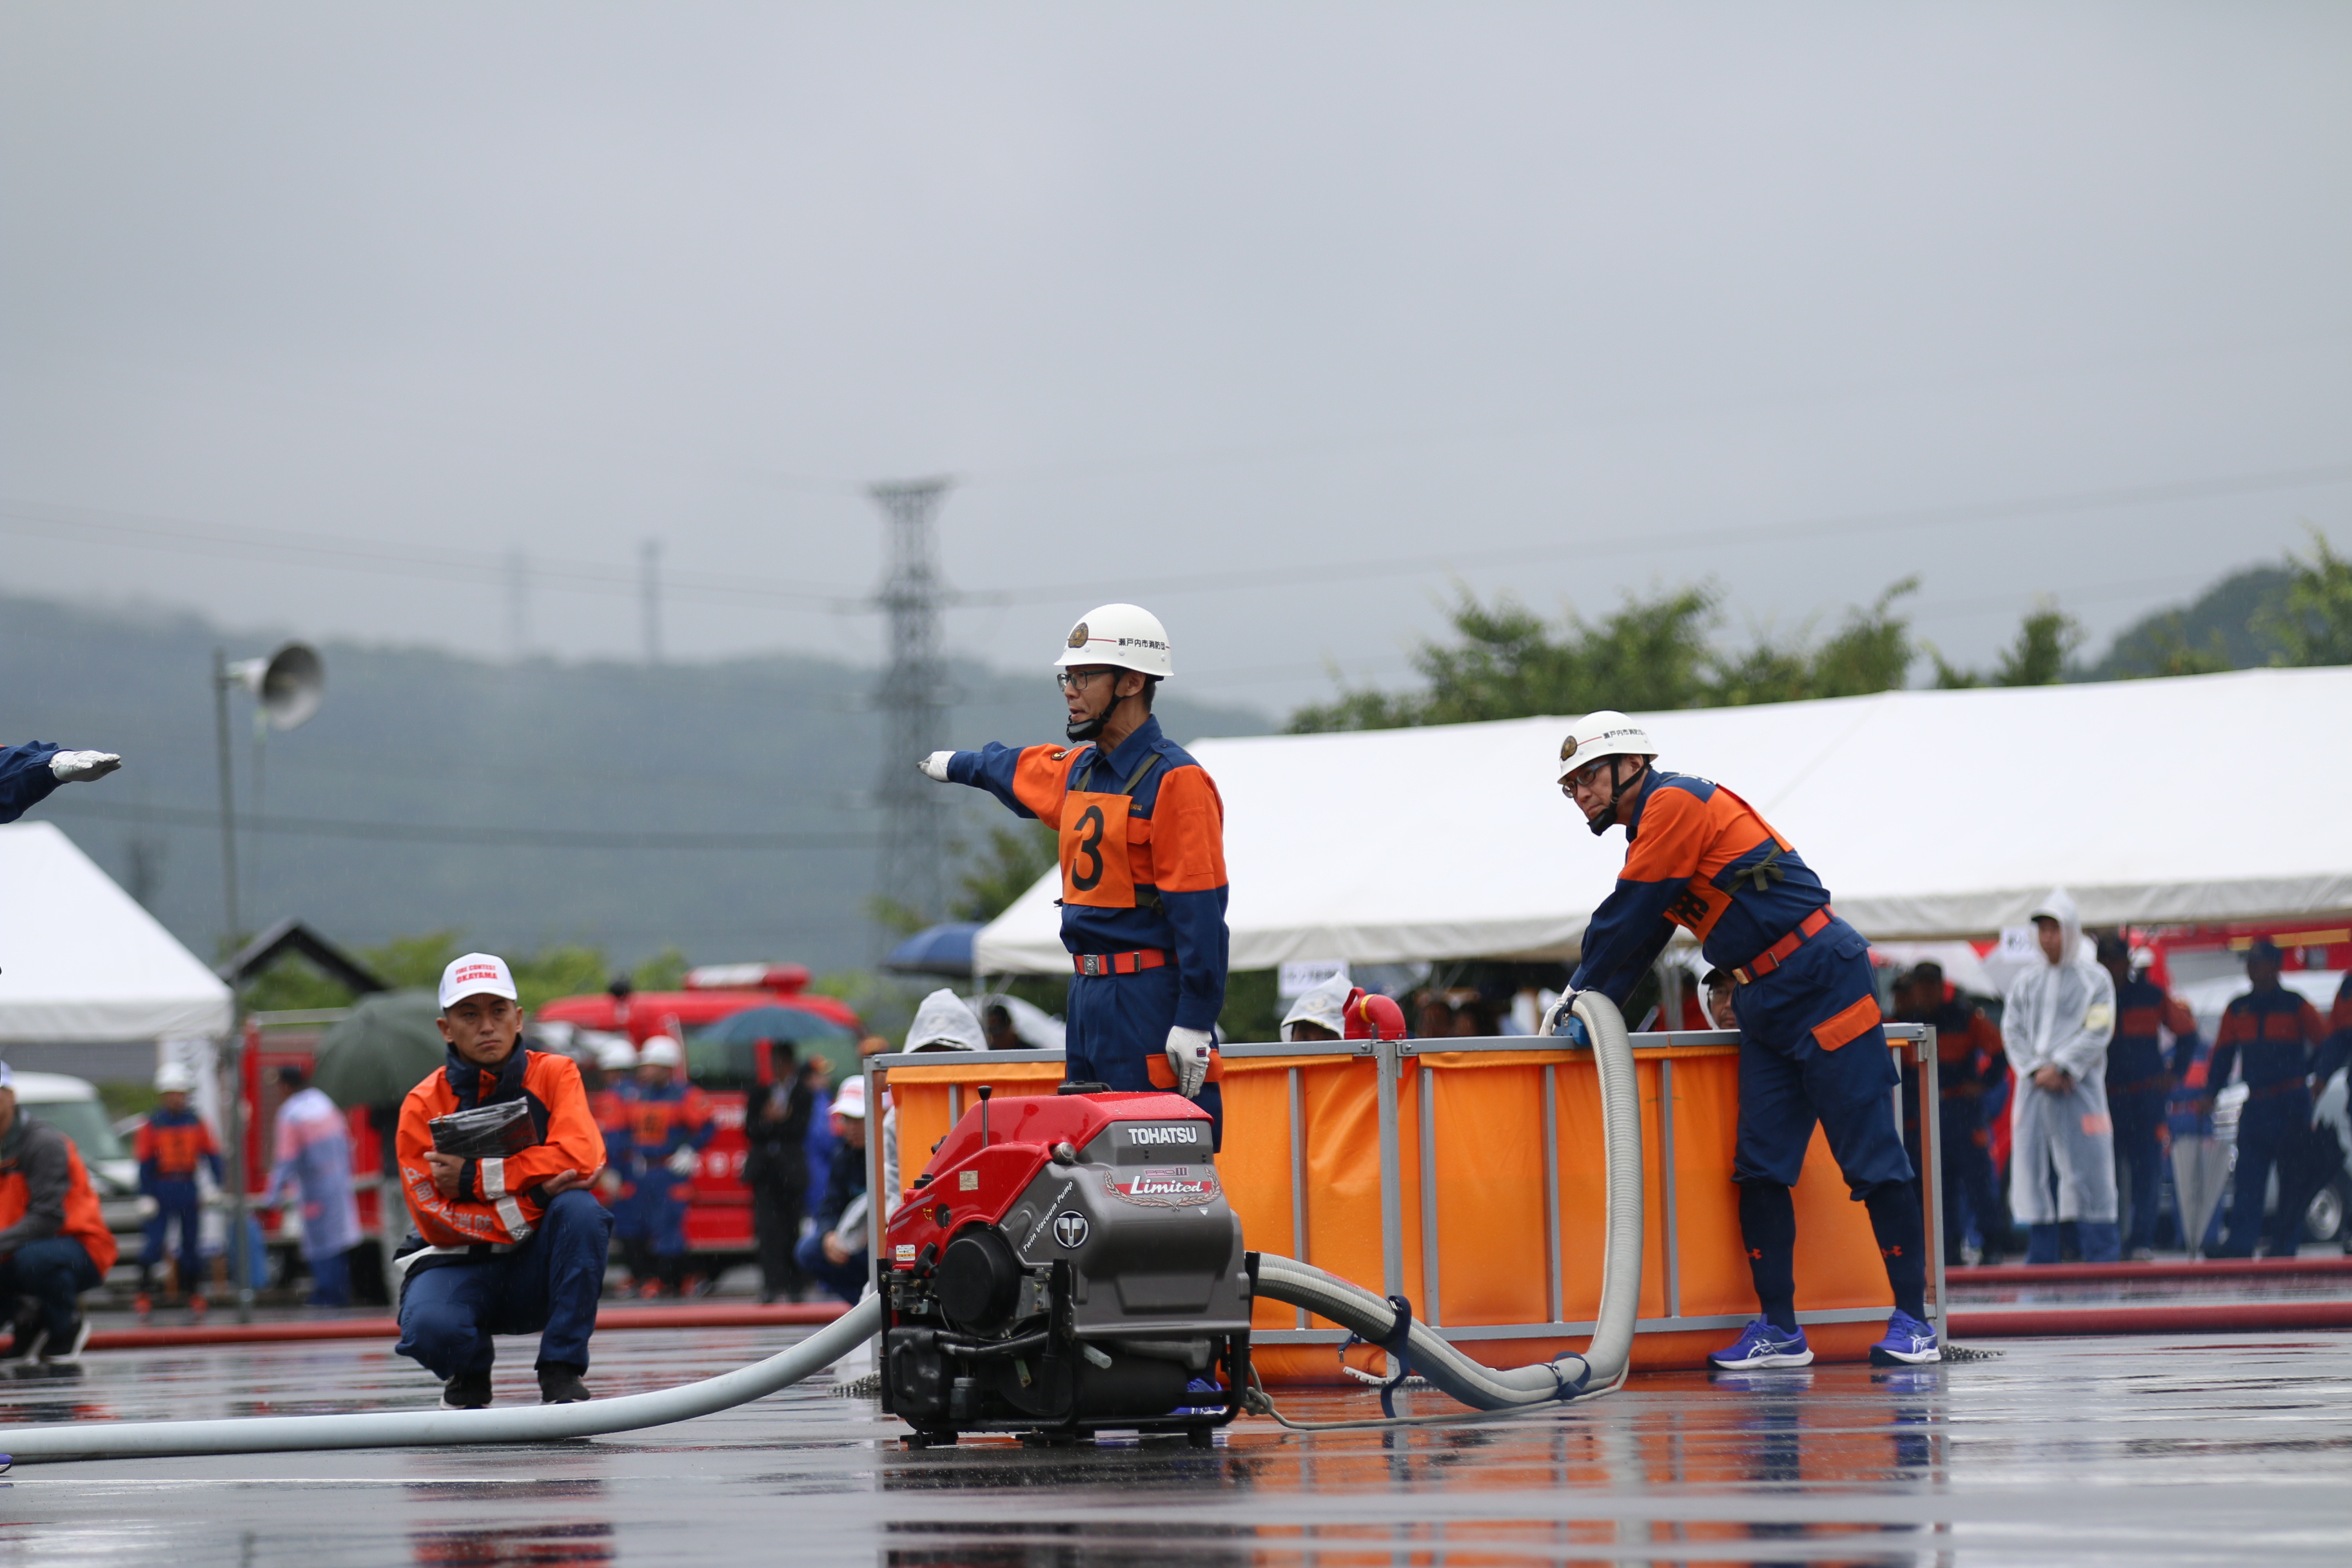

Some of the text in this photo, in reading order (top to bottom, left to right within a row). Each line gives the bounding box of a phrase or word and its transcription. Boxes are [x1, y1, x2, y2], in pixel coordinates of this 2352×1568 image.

[1119, 638, 1165, 650] 瀬戸内市消防団
[1072, 805, 1104, 891] 3
[456, 972, 498, 983] OKAYAMA
[1128, 1127, 1197, 1144] TOHATSU
[1130, 1176, 1203, 1195] Limited
[1023, 1181, 1073, 1252] Twin Vacuum Pump
